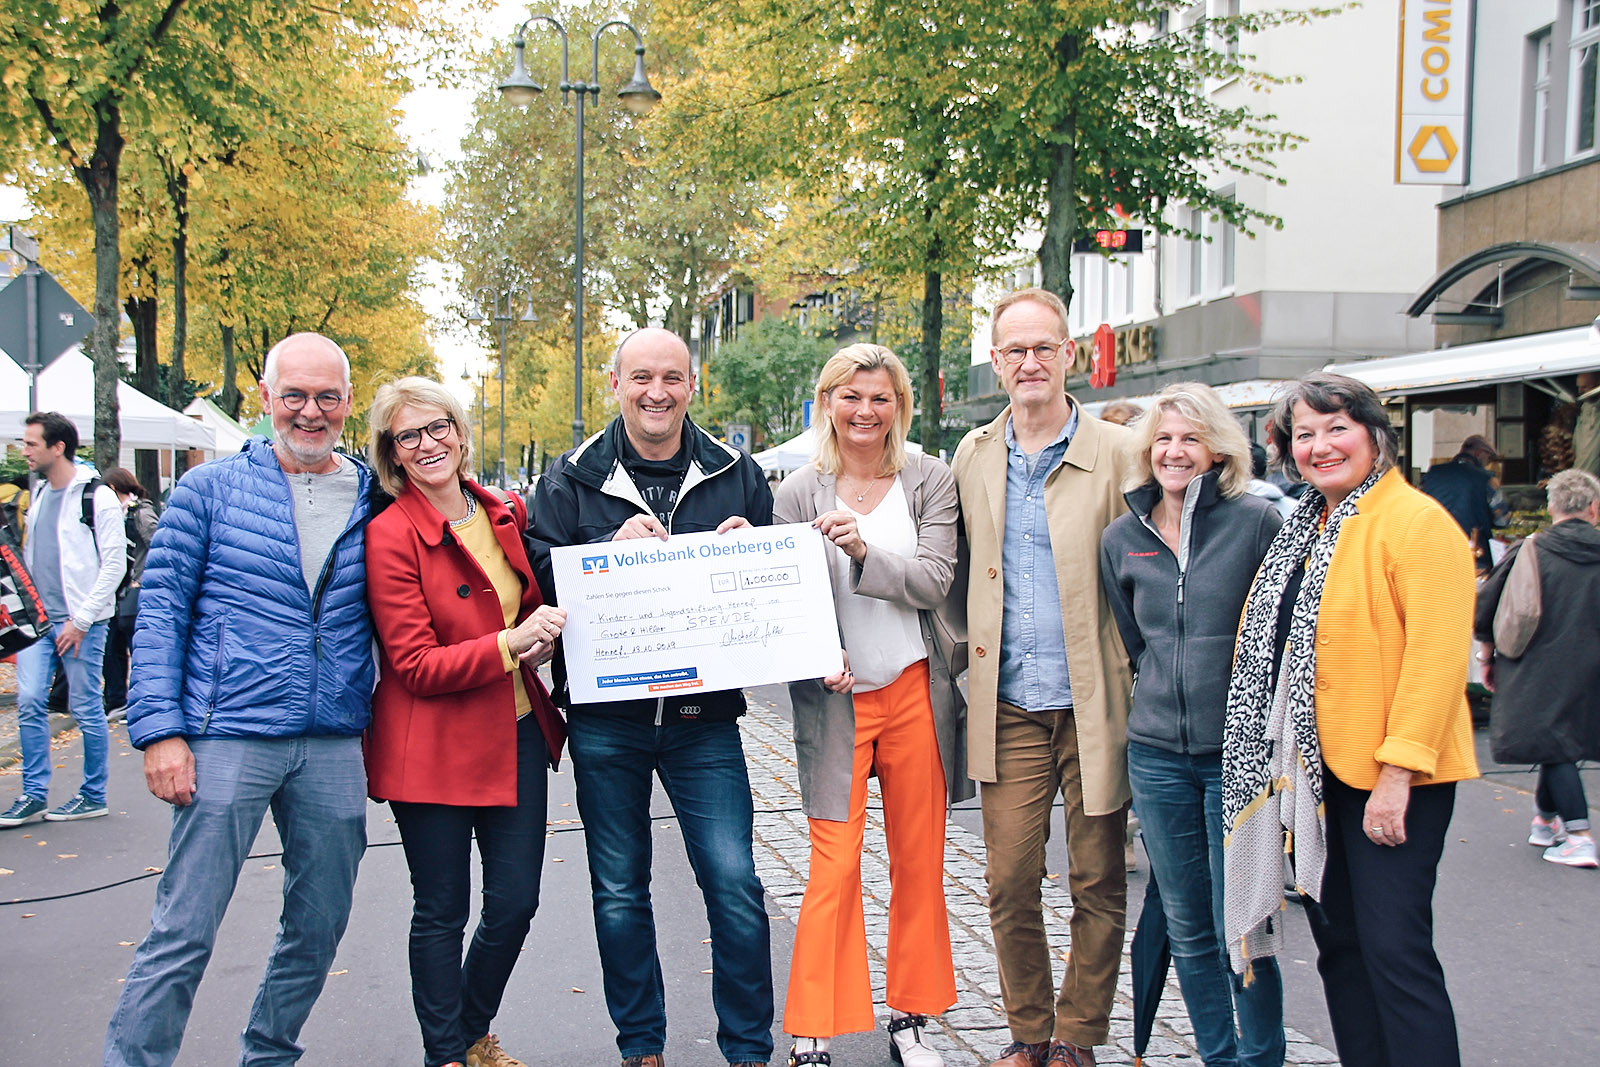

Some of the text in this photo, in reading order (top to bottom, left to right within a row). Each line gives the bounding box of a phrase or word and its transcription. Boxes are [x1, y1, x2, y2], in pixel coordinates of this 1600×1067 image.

[641, 486, 677, 503] ITY R
[614, 536, 796, 568] Volksbank Oberberg eG
[585, 592, 604, 600] Zahlen
[614, 590, 633, 600] gegen
[633, 588, 651, 597] diesen
[652, 586, 671, 595] Scheck
